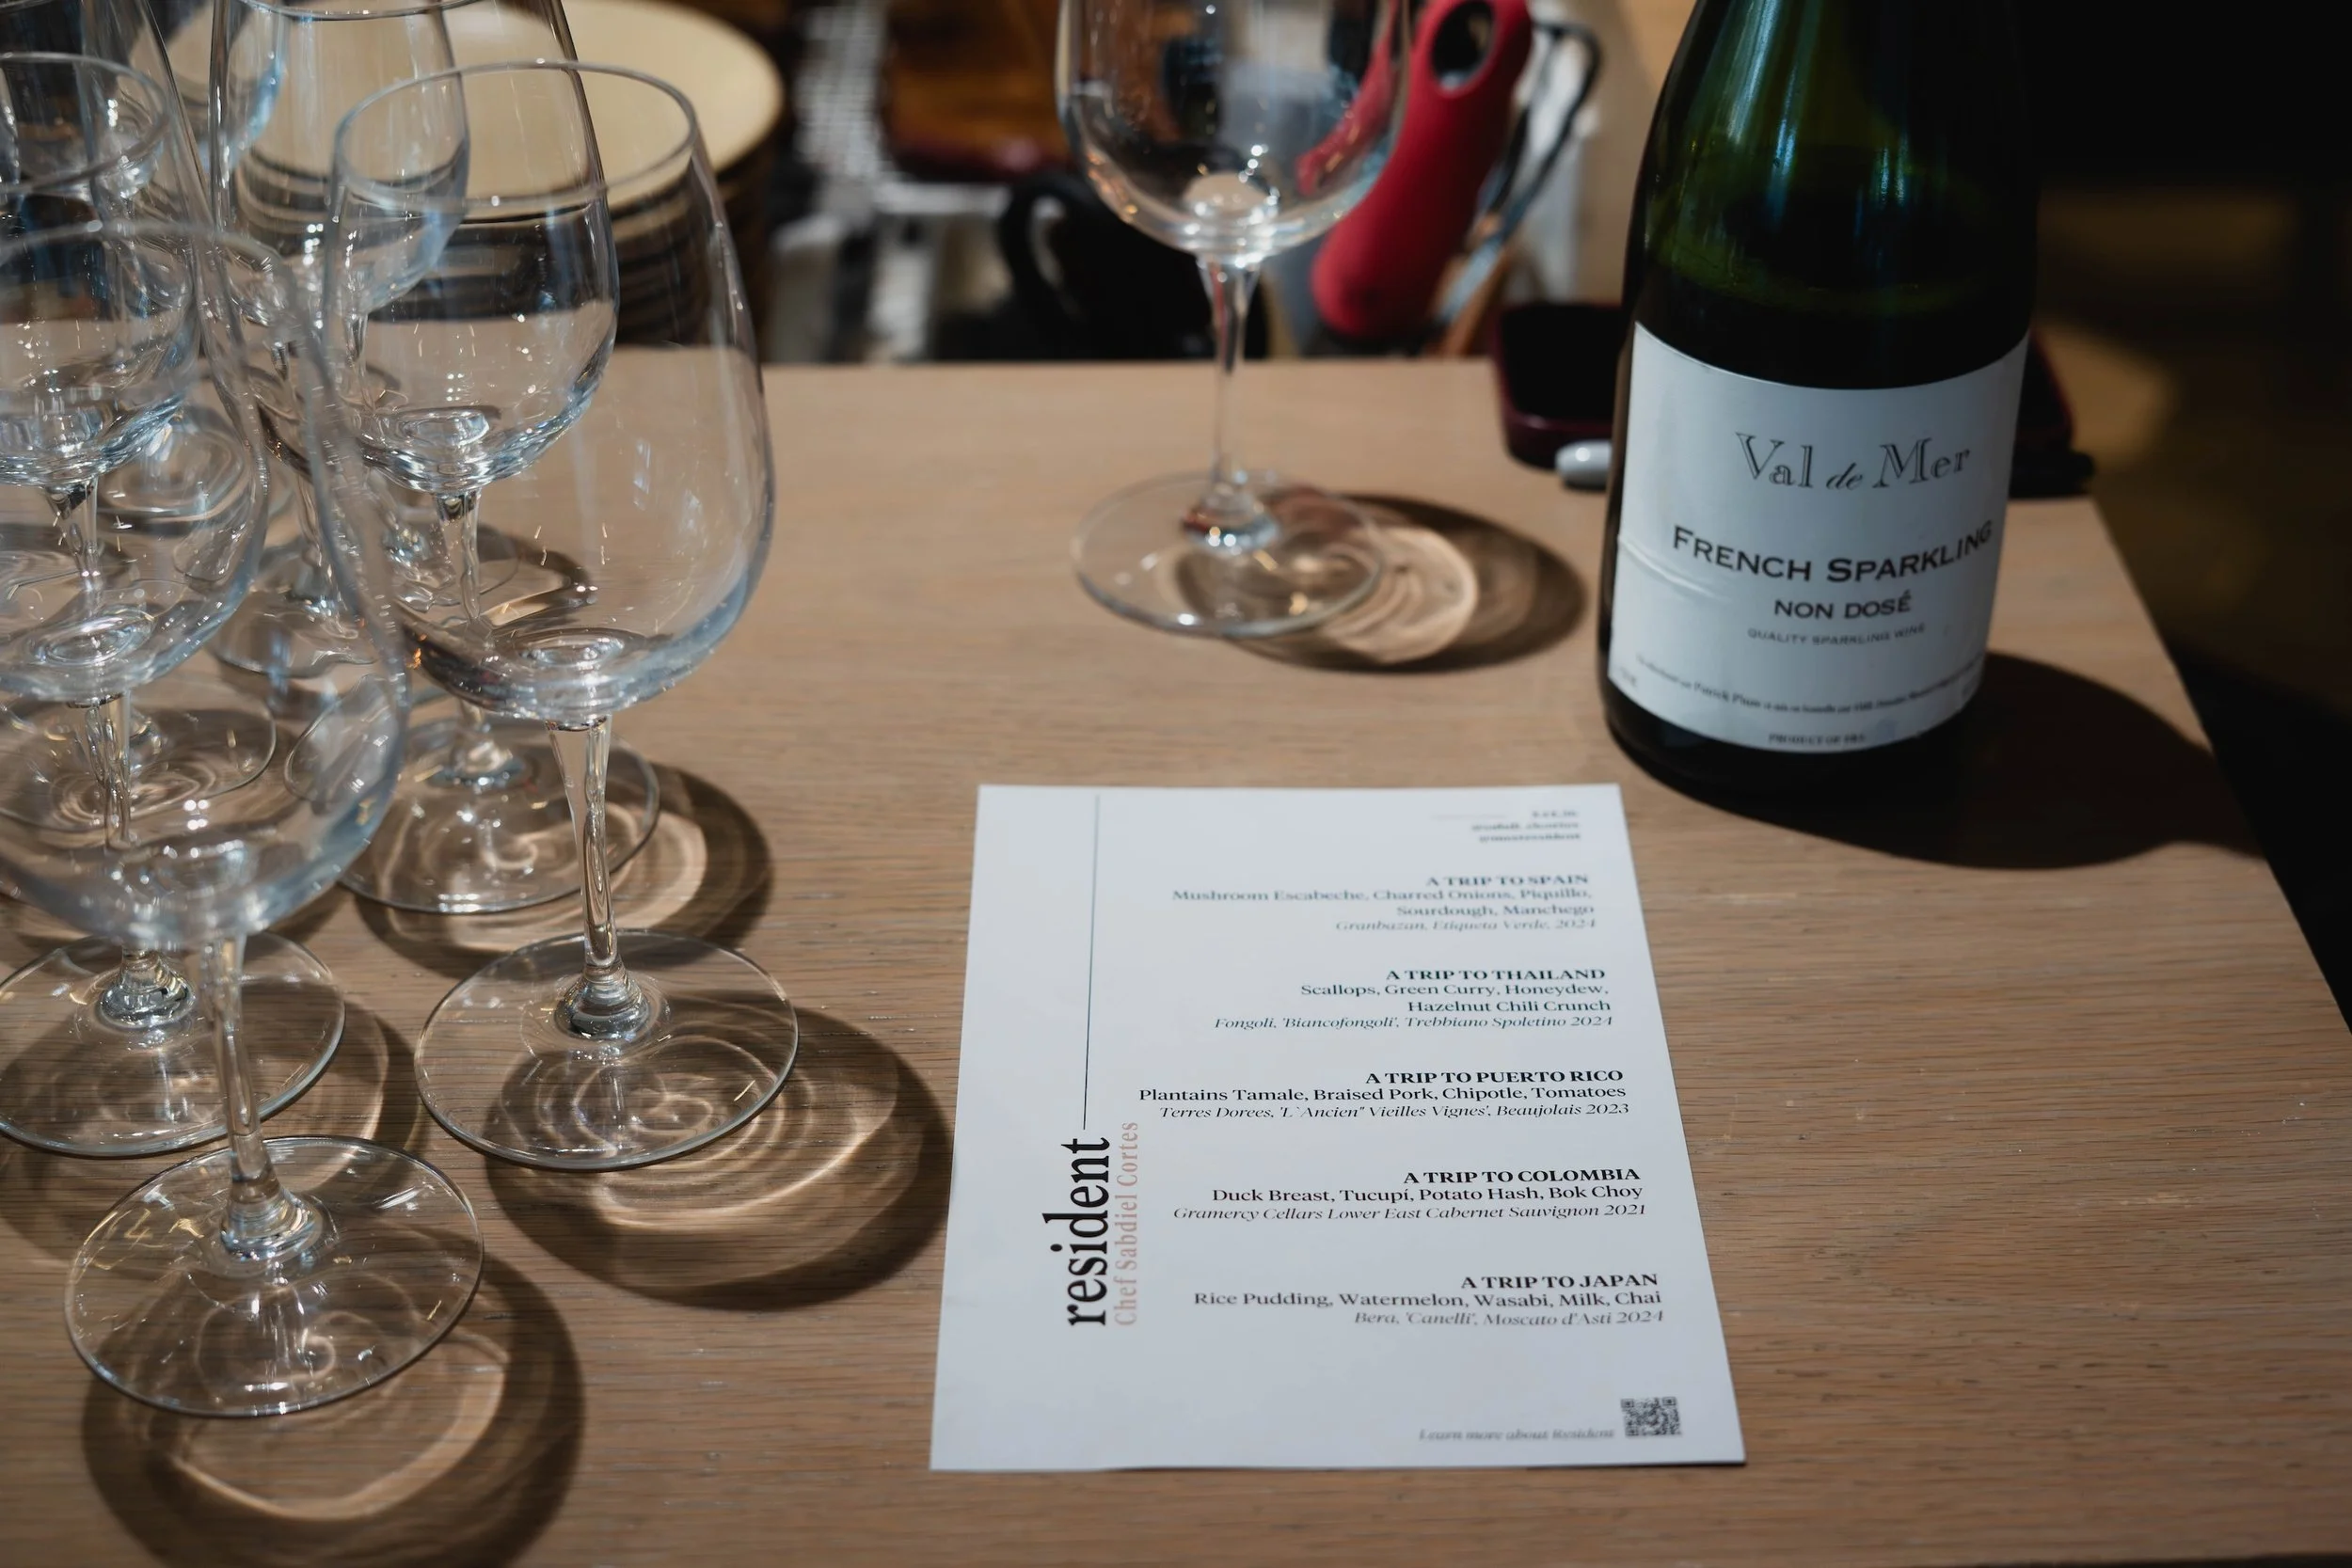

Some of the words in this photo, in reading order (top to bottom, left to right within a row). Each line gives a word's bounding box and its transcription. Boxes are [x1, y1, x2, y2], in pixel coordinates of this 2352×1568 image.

[1736, 432, 1813, 487] Val
[1826, 463, 1864, 490] de
[1872, 438, 1970, 488] Mer
[1674, 526, 1811, 581] FRENCH
[1827, 520, 1993, 582] SPARKLING
[1774, 599, 1834, 619] NON
[1844, 591, 1912, 619] DOSÉ
[1747, 627, 1806, 644] QUALITY
[1811, 632, 1890, 645] SPARKLING
[1894, 623, 1925, 639] WINE
[1425, 877, 1439, 886] A
[1443, 876, 1492, 886] TRIP
[1496, 876, 1524, 885] TO
[1527, 875, 1589, 885] SPAIN
[1171, 890, 1269, 900] Mushroom
[1374, 890, 1444, 900] Charred
[1448, 889, 1516, 900] Onions,
[1397, 906, 1499, 917] Sourdough,
[1502, 905, 1595, 917] Manchego
[1386, 970, 1401, 980] A
[1404, 970, 1455, 980] TRIP
[1458, 970, 1488, 980] TO
[1491, 969, 1606, 980] THAILAND
[1300, 984, 1380, 997] Scallops,
[1384, 984, 1438, 994] Green
[1443, 984, 1501, 996] Curry,
[1505, 983, 1610, 996] Honeydew,
[1408, 1001, 1491, 1012] Hazelnut
[1496, 1000, 1539, 1012] Chili
[1544, 1000, 1612, 1011] Crunch
[1215, 1017, 1277, 1030] Fongoli,
[1405, 1017, 1488, 1028] Trebbiano
[1491, 1016, 1566, 1029] Spoletino
[1570, 1016, 1613, 1027] 2024
[1366, 1073, 1381, 1084] A
[1385, 1072, 1438, 1084] TRIP
[1441, 1071, 1472, 1084] TO
[1476, 1070, 1565, 1083] PUERTO
[1569, 1069, 1624, 1082] RICO
[1138, 1088, 1228, 1101] Plantains
[1232, 1088, 1309, 1101] Tamale,
[1313, 1087, 1383, 1101] Braised
[1389, 1087, 1438, 1101] Pork,
[1442, 1086, 1528, 1101] Chipotle,
[1531, 1086, 1627, 1099] Tomatoes
[1159, 1106, 1212, 1118] Terres
[1216, 1106, 1274, 1118] Dorees,
[1369, 1105, 1426, 1117] Vieilles
[1497, 1103, 1581, 1117] Beaujolais
[1585, 1103, 1629, 1116] 2023
[1117, 1122, 1138, 1186] Cortes
[1404, 1172, 1420, 1184] A
[1423, 1172, 1478, 1183] TRIP
[1482, 1171, 1514, 1183] TO
[1518, 1168, 1642, 1182] COLOMBIA
[1212, 1189, 1263, 1201] Duck
[1269, 1189, 1335, 1202] Breast,
[1339, 1188, 1415, 1204] Tucupí,
[1420, 1188, 1483, 1201] Potato
[1487, 1186, 1544, 1201] Hash,
[1549, 1186, 1587, 1199] Bok
[1591, 1185, 1644, 1200] Choy
[1173, 1208, 1259, 1222] Gramercy
[1263, 1208, 1324, 1220] Cellars
[1327, 1208, 1381, 1220] Lower
[1384, 1208, 1422, 1219] East
[1425, 1207, 1505, 1219] Cabernet
[1508, 1205, 1599, 1220] Sauvignon
[1604, 1204, 1646, 1216] 2021
[1041, 1137, 1110, 1326] resident
[1115, 1195, 1137, 1270] Sabdiel
[1461, 1276, 1477, 1289] A
[1482, 1275, 1537, 1289] TRIP
[1542, 1275, 1575, 1288] TO
[1580, 1274, 1659, 1288] JAPAN
[1113, 1275, 1137, 1326] Chef
[1194, 1292, 1238, 1305] Rice
[1243, 1292, 1333, 1307] Pudding,
[1339, 1293, 1469, 1307] Watermelon,
[1474, 1293, 1553, 1307] Wasabi,
[1559, 1292, 1611, 1307] Milk,
[1614, 1291, 1661, 1305] Chai
[1483, 1313, 1557, 1325] Moscato
[1617, 1310, 1664, 1323] 2024
